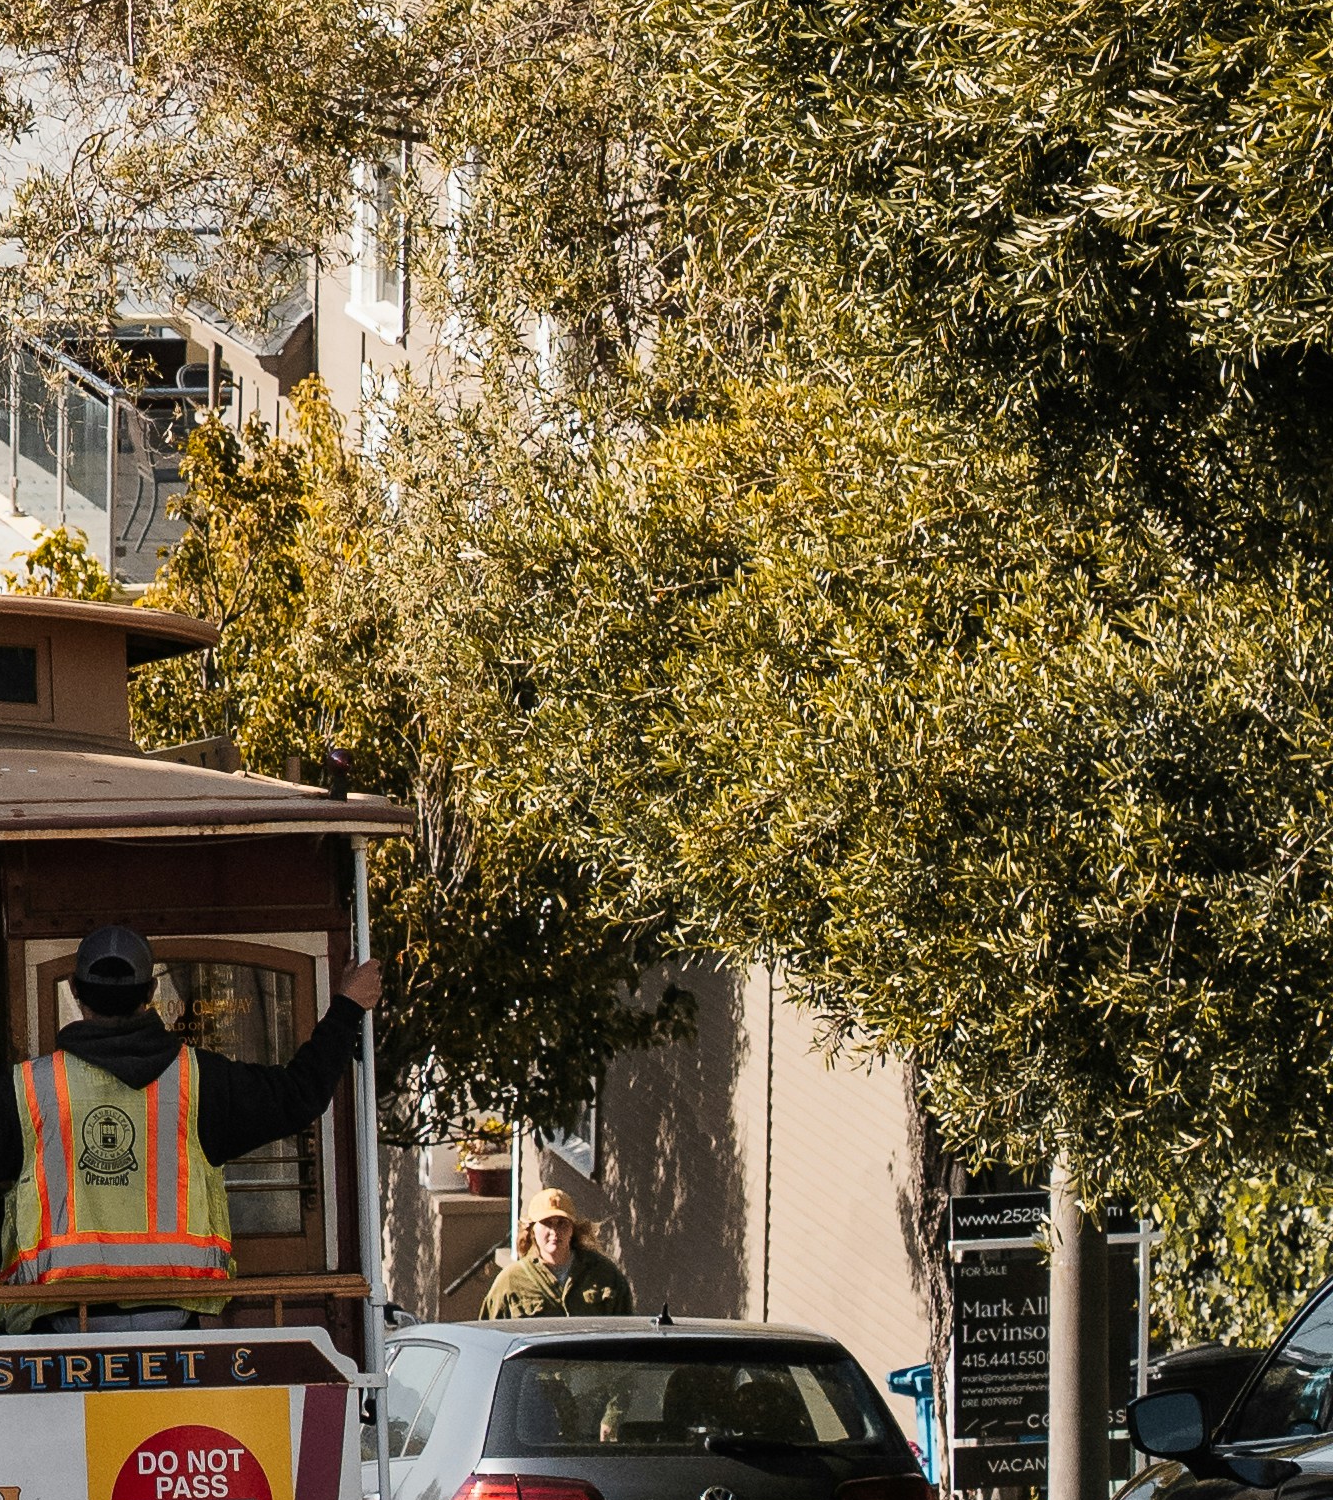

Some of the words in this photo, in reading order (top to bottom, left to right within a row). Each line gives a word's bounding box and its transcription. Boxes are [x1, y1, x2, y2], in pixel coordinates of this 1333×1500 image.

[90, 1145, 126, 1159] RAILWAY
[85, 1171, 130, 1187] OPERATIONS
[957, 1207, 1046, 1227] www.2528
[960, 1267, 981, 1277] FOR
[983, 1265, 1008, 1276] SALE
[963, 1298, 1015, 1319] Mark
[1021, 1296, 1048, 1316] All
[963, 1322, 1050, 1344] Levinso
[961, 1371, 1049, 1384] mark@markallanlevi
[961, 1397, 979, 1408] DRE
[137, 1451, 180, 1477] DO
[186, 1448, 246, 1475] NOT
[987, 1457, 1048, 1474] VACAN
[155, 1474, 230, 1500] PASS
